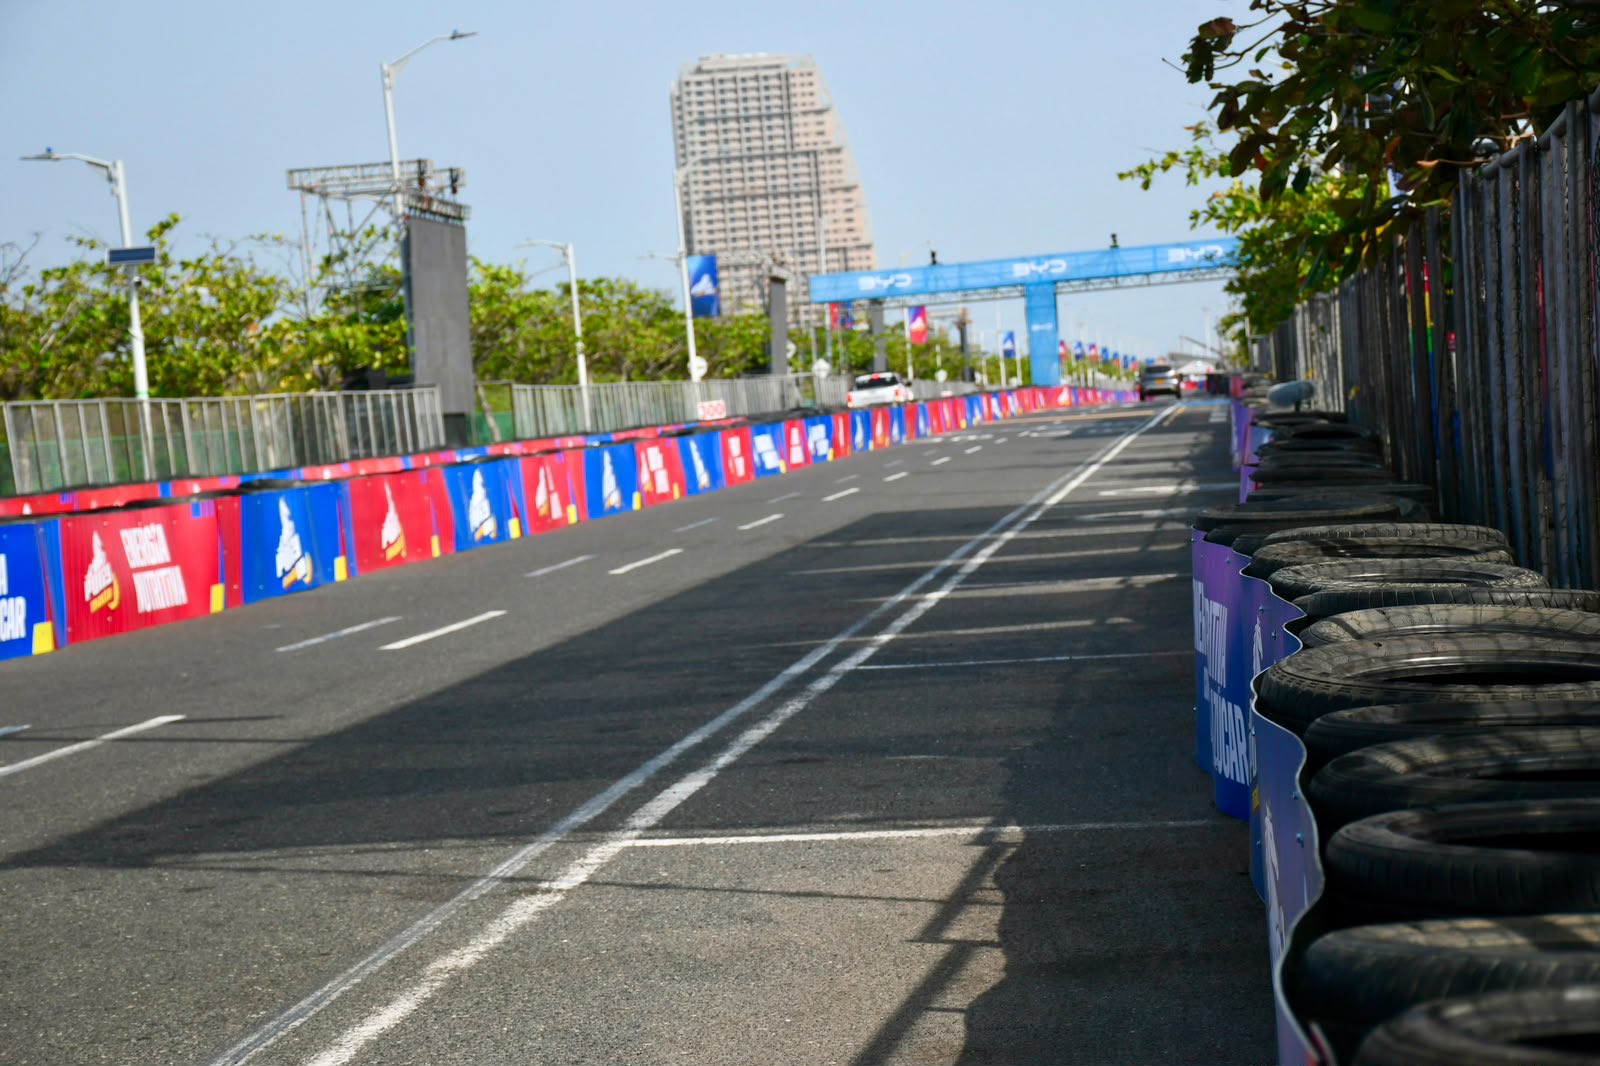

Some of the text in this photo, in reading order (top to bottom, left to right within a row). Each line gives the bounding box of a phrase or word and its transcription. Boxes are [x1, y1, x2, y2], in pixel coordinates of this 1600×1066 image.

[1167, 246, 1225, 264] BYD
[1012, 260, 1066, 277] BYD
[858, 274, 913, 291] BYD
